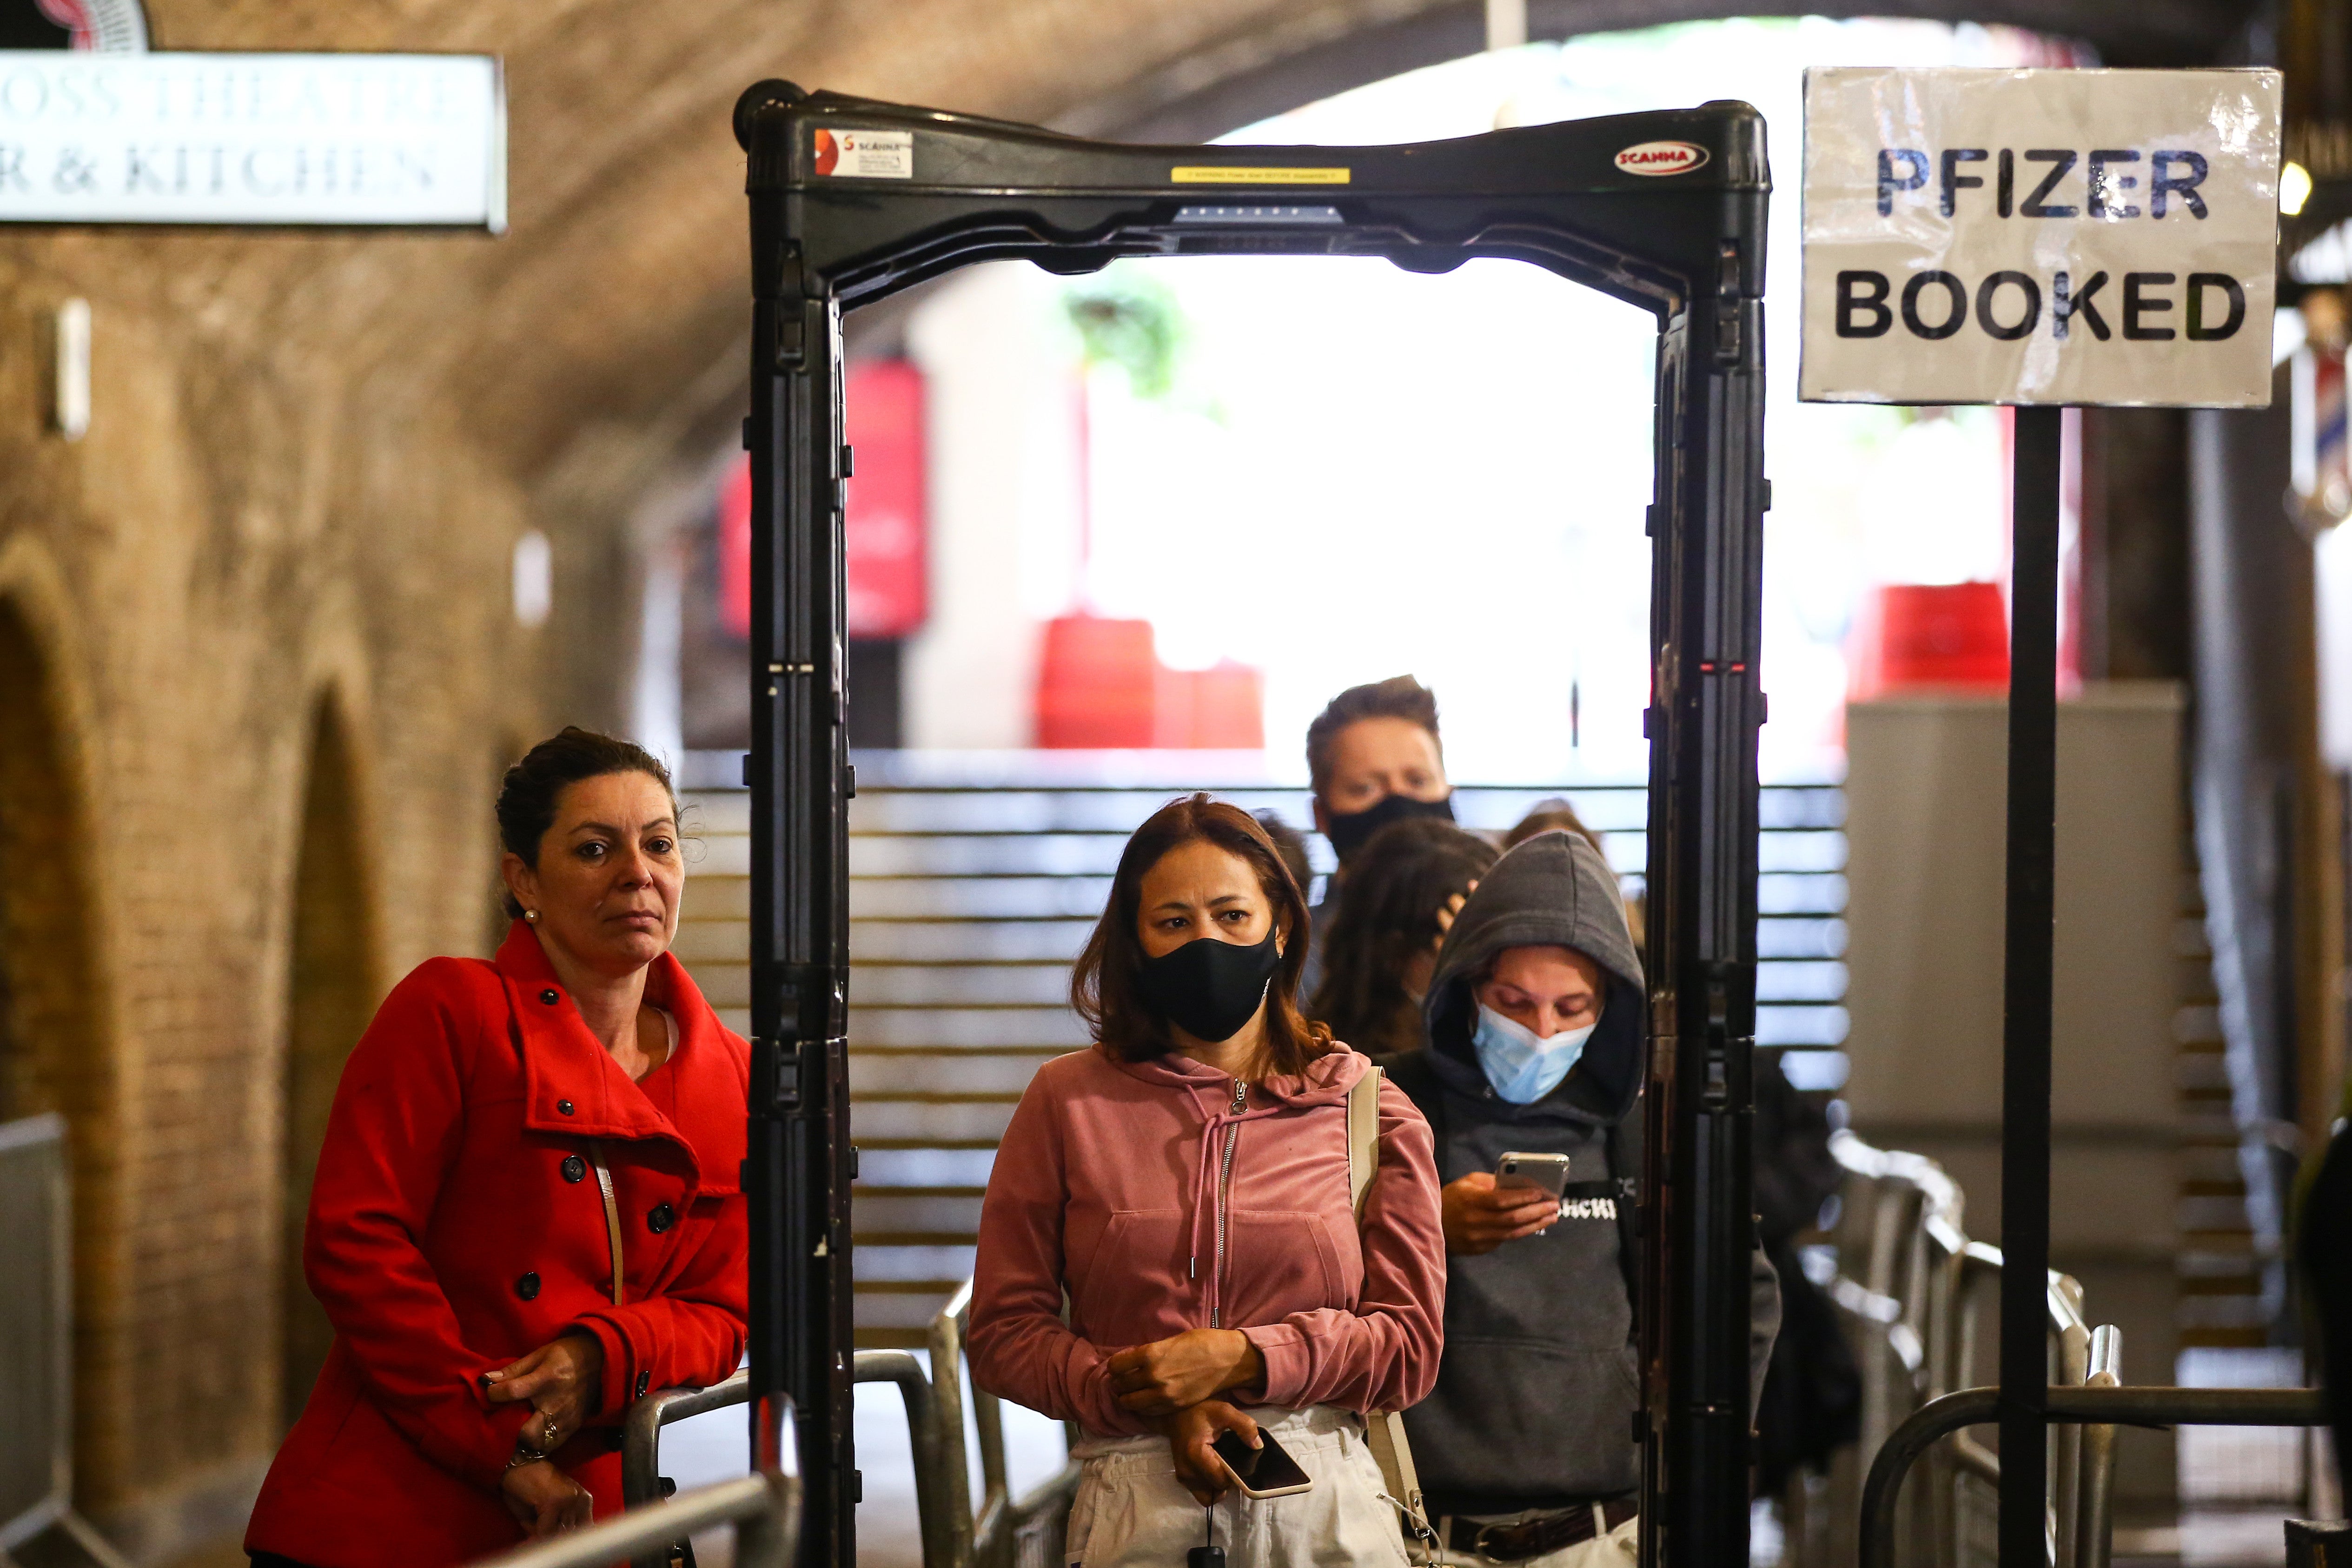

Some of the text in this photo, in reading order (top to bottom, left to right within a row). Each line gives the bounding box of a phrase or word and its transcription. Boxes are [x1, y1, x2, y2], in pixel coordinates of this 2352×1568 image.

[141, 67, 464, 126] THEATRE
[50, 145, 98, 195] &
[124, 144, 437, 196] KITCHEN
[1619, 151, 1689, 164] SCANNA
[1876, 148, 2209, 220] PFIZER
[1835, 270, 2246, 342] BOOKED
